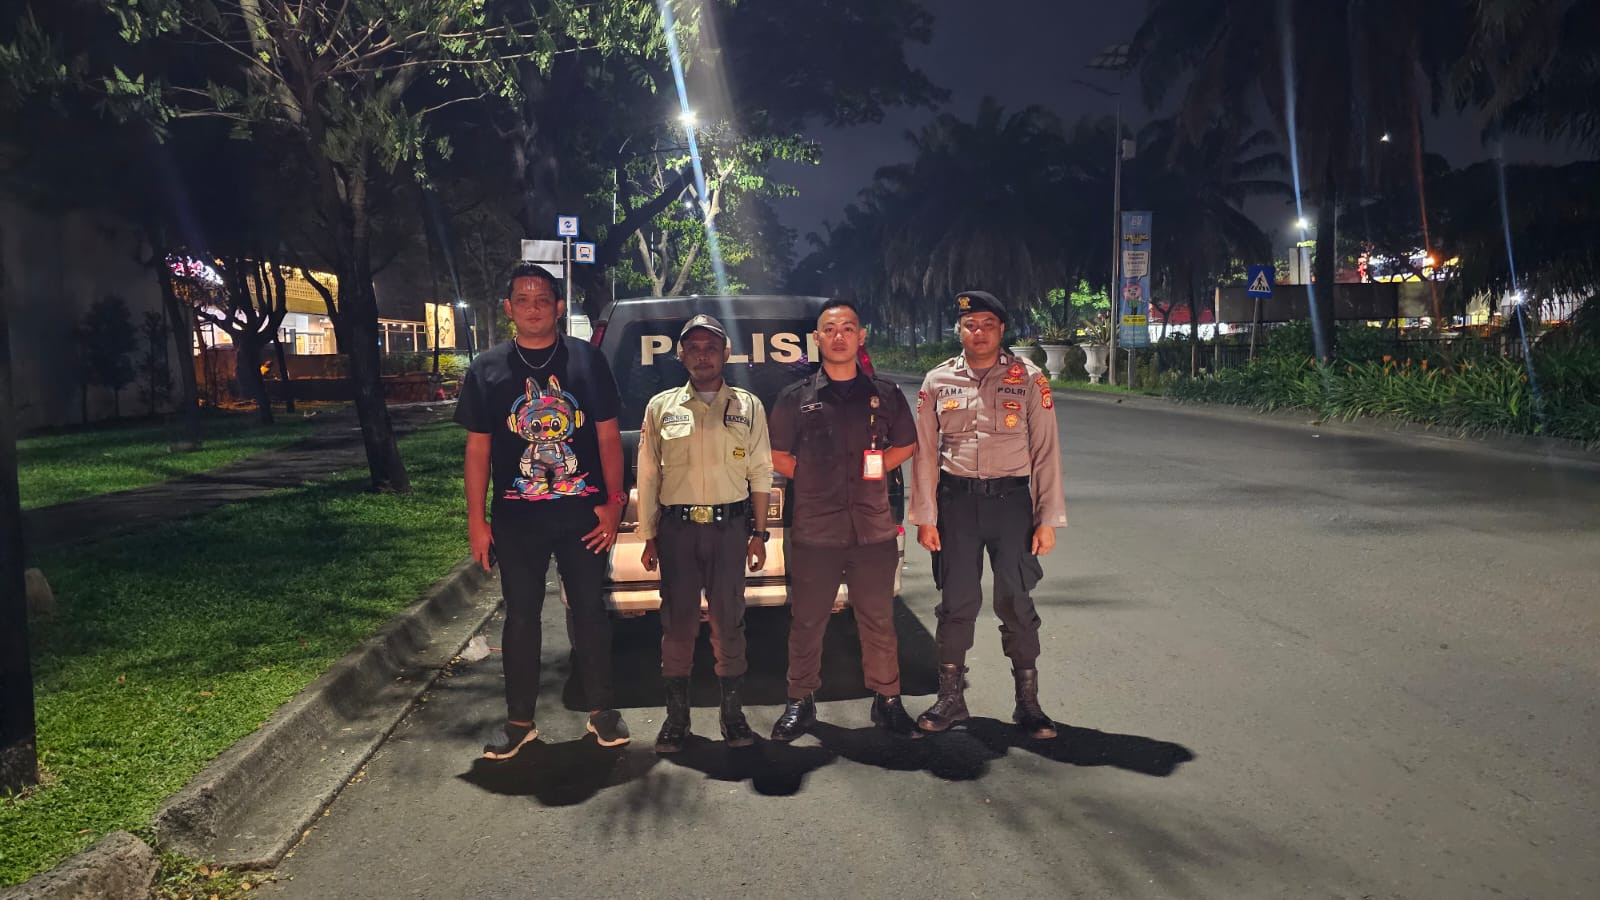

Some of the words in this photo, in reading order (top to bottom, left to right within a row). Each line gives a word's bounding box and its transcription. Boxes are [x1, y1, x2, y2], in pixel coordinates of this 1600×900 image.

[641, 333, 820, 365] PLISI
[939, 388, 963, 397] TAMA
[997, 387, 1026, 397] POLRI
